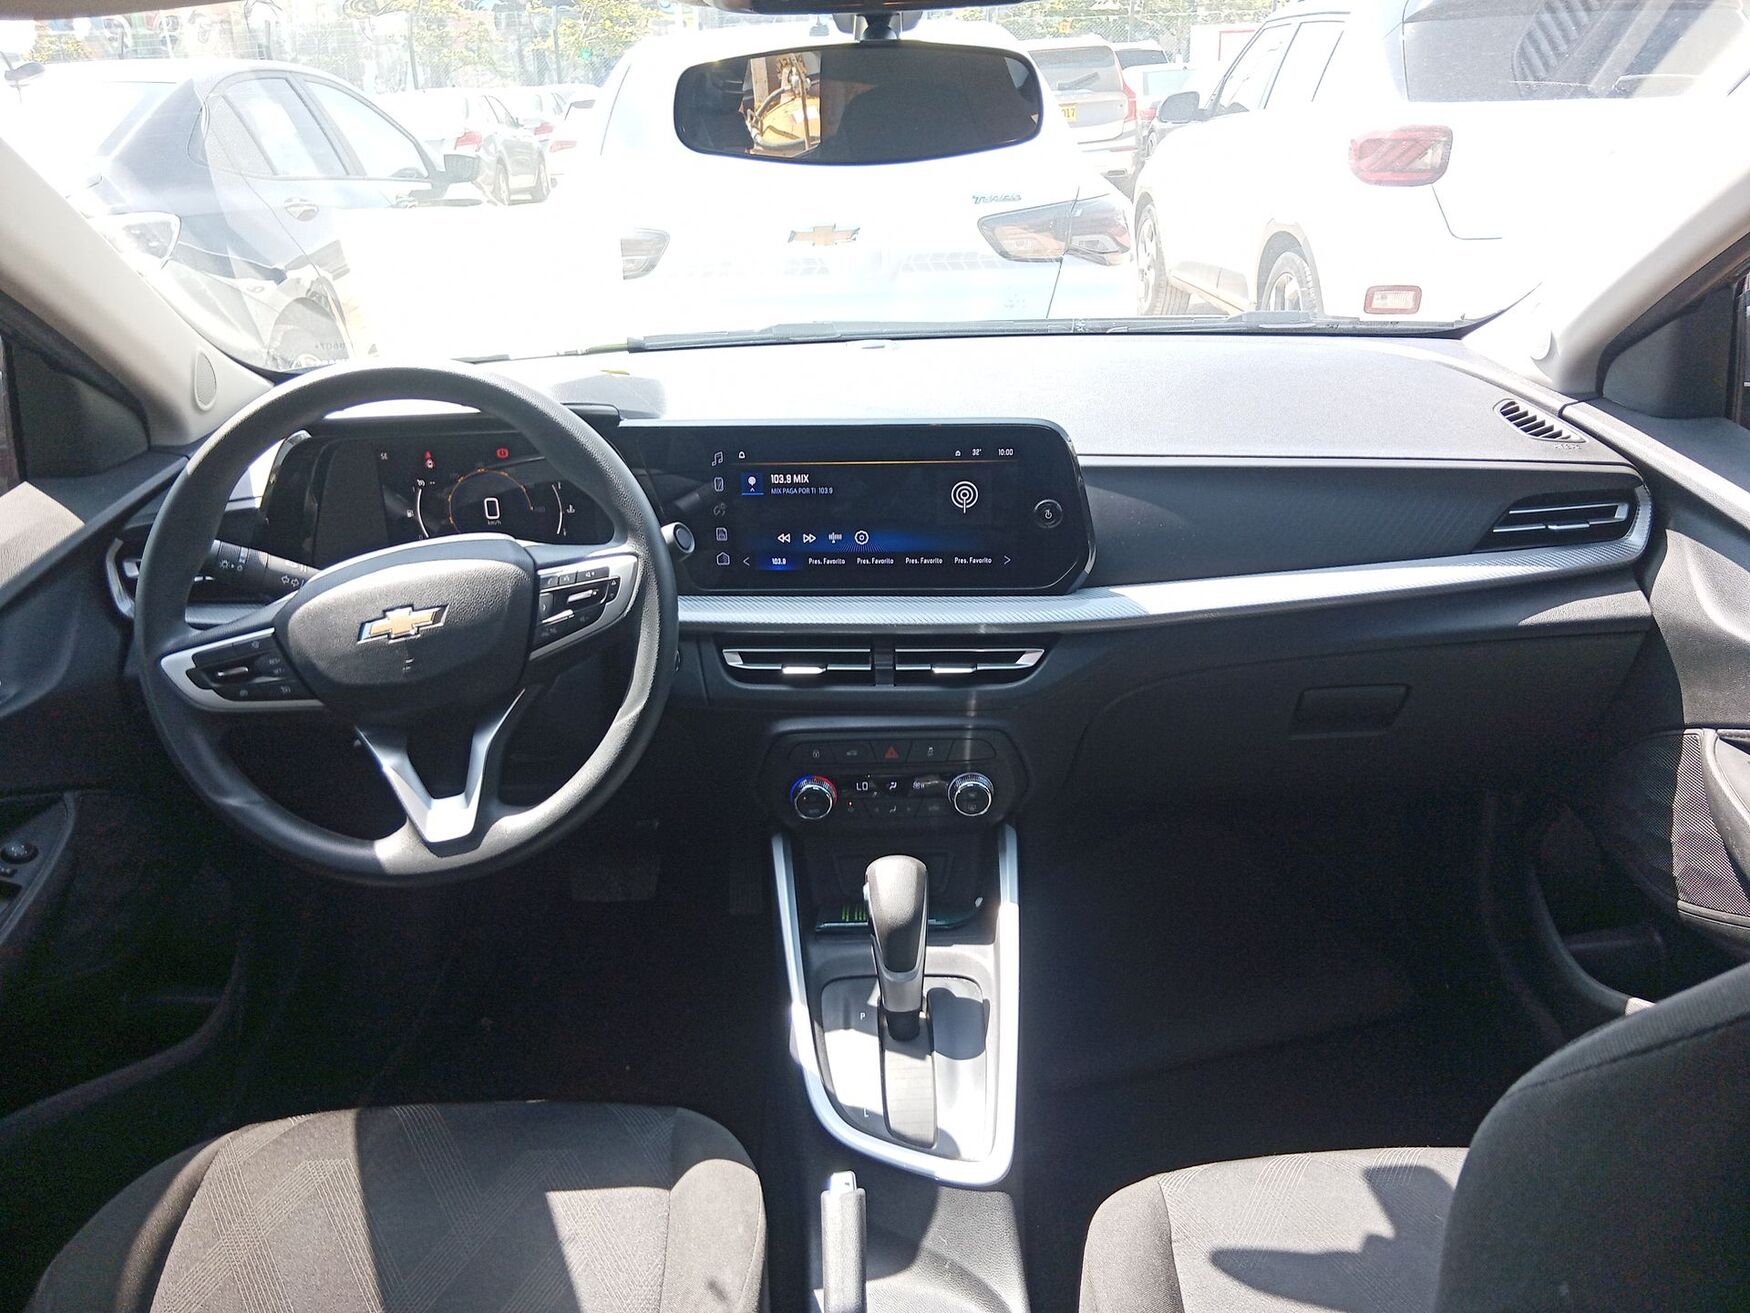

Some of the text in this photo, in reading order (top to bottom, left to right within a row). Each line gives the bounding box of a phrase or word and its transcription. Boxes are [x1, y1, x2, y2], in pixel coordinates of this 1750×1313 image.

[998, 448, 1014, 456] 10:00
[793, 473, 809, 483] MIX
[808, 557, 846, 565] Pres. Favorito
[856, 557, 894, 565] Pres. Favorito
[954, 556, 992, 564] Pres. Favorito
[856, 782, 869, 791] LO
[860, 1012, 866, 1021] P
